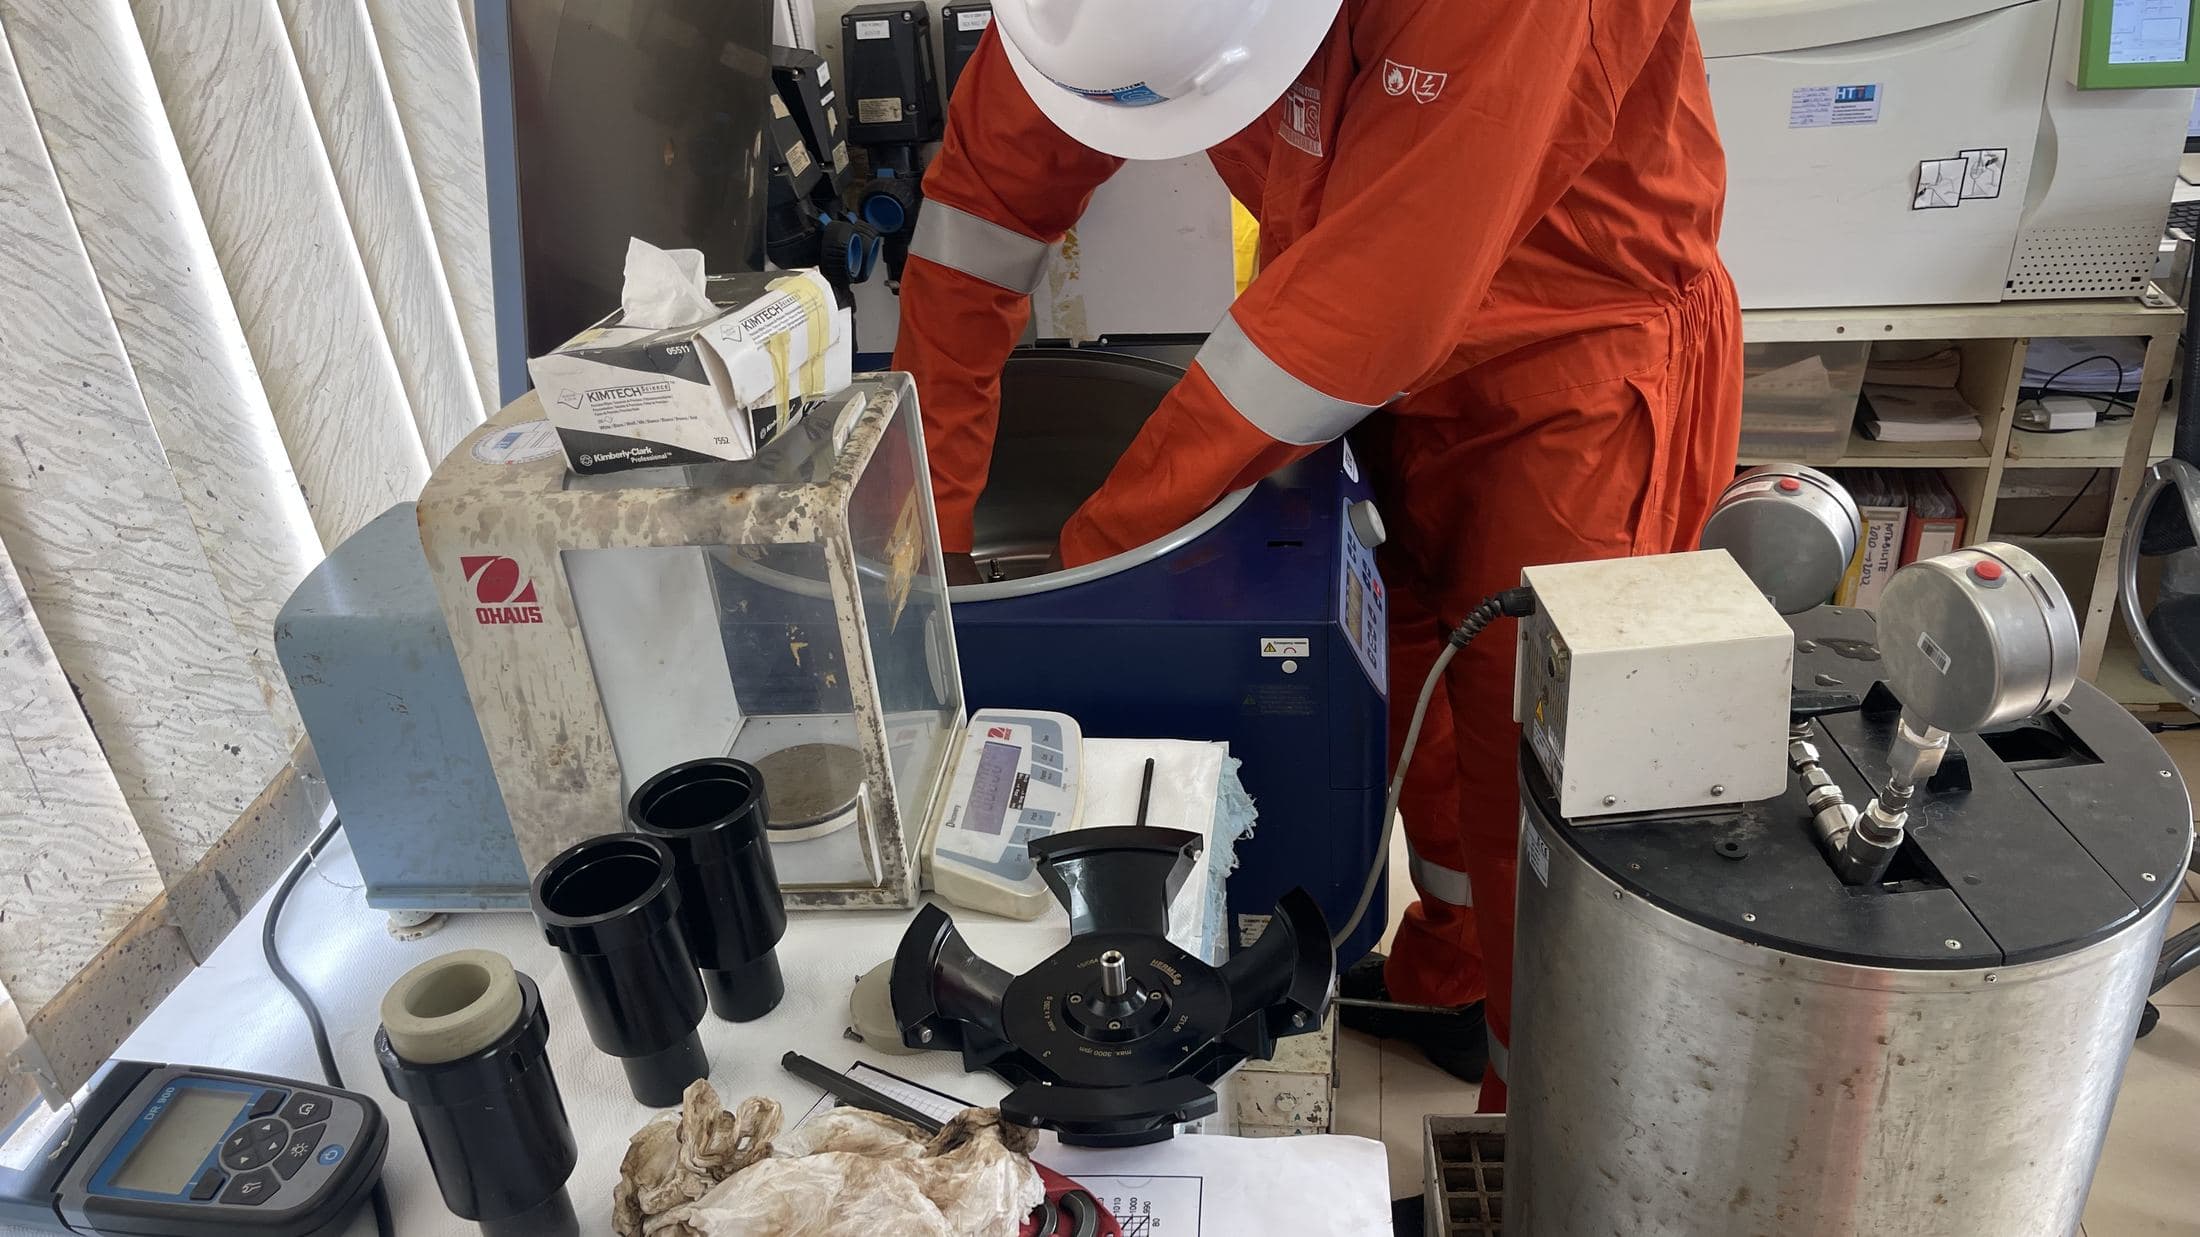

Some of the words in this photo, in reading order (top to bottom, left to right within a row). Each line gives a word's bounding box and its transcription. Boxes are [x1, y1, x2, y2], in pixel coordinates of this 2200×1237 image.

[742, 303, 784, 332] KIMTECH
[665, 345, 691, 356] 05511
[586, 387, 642, 403] KIMTECH
[713, 436, 731, 445] 7552
[593, 446, 653, 463] Kimberly-Clark
[475, 606, 544, 625] OHAUS
[144, 1106, 161, 1119] DR
[157, 1088, 175, 1103] 900
[1113, 1197, 1121, 1213] 1010
[1129, 1197, 1137, 1213] 1000
[1143, 1201, 1151, 1214] 990
[1152, 1218, 1160, 1227] 80
